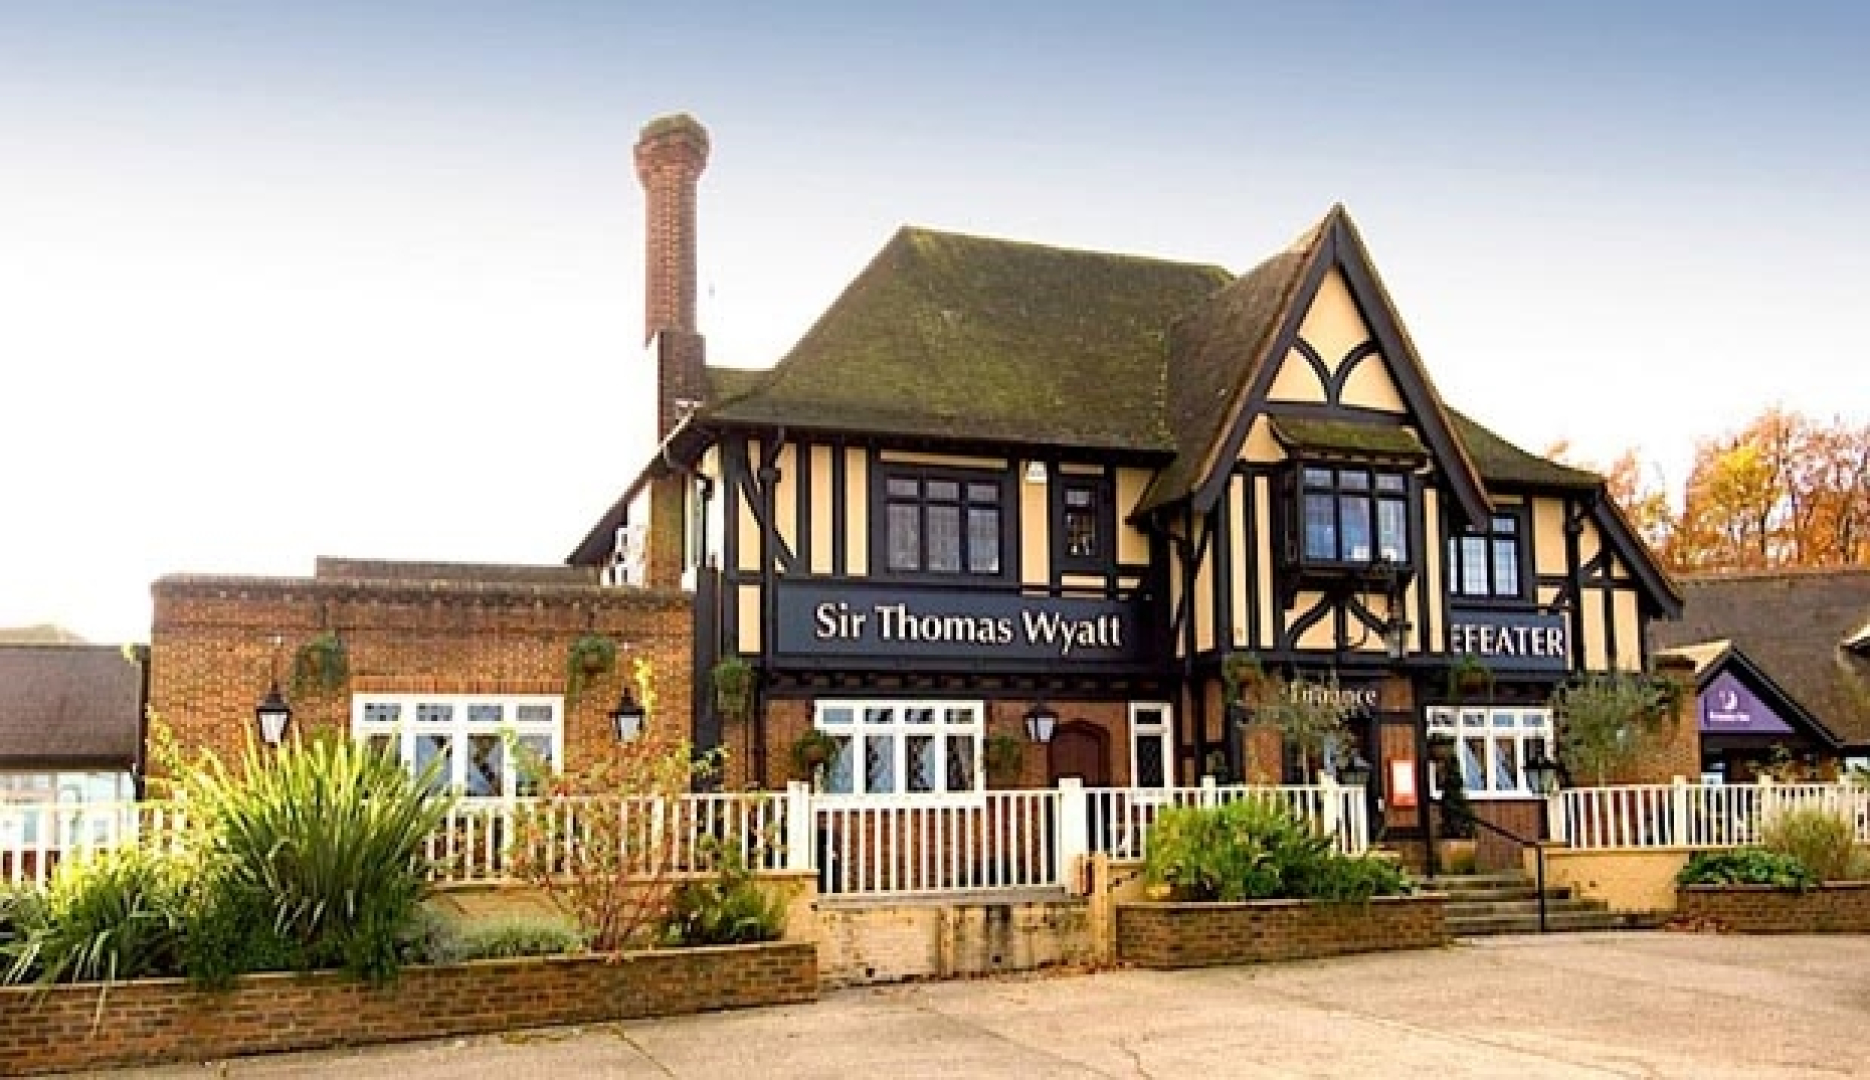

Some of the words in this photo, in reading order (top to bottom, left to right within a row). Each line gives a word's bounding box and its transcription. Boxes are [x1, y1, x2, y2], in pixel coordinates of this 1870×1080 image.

[815, 602, 866, 639] Sir
[874, 604, 1013, 644] Thomas
[1022, 610, 1122, 655] Wyatt
